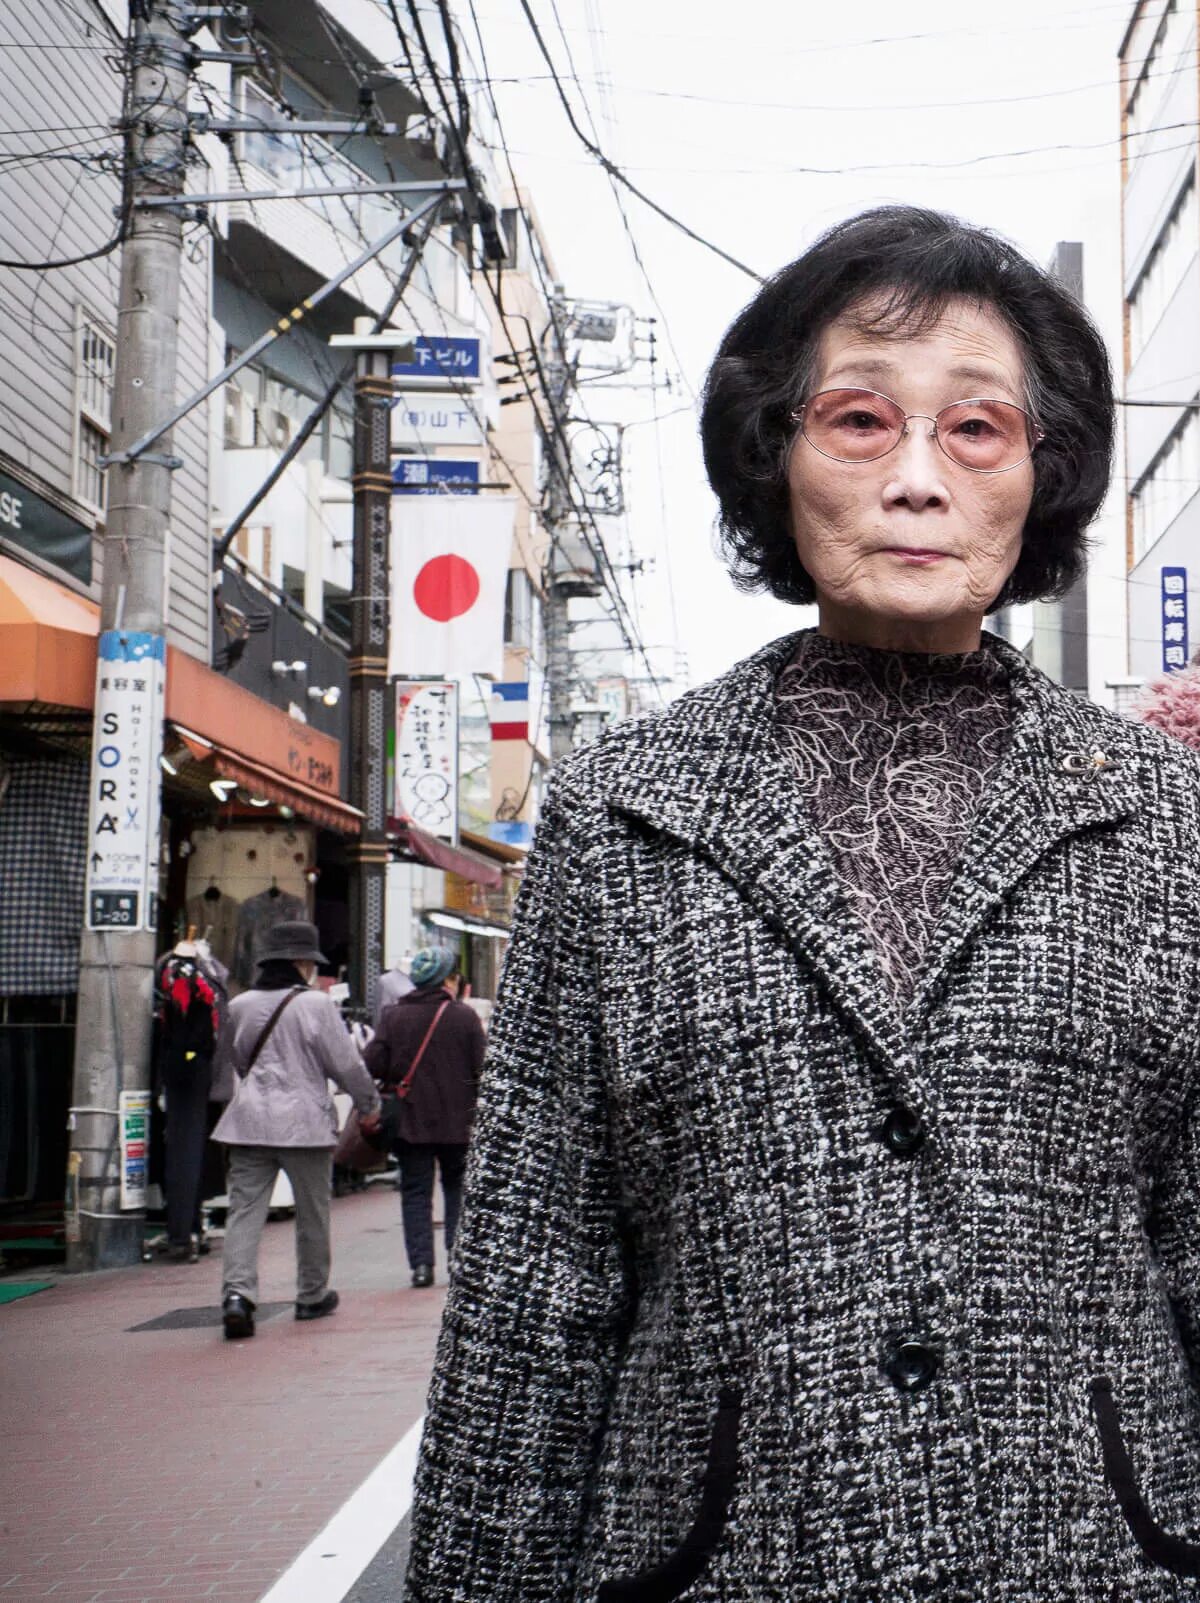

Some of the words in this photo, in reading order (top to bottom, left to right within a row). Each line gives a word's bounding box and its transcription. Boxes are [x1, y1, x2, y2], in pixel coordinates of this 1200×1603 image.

[402, 346, 473, 367] 下ビル
[96, 711, 121, 835] SORA
